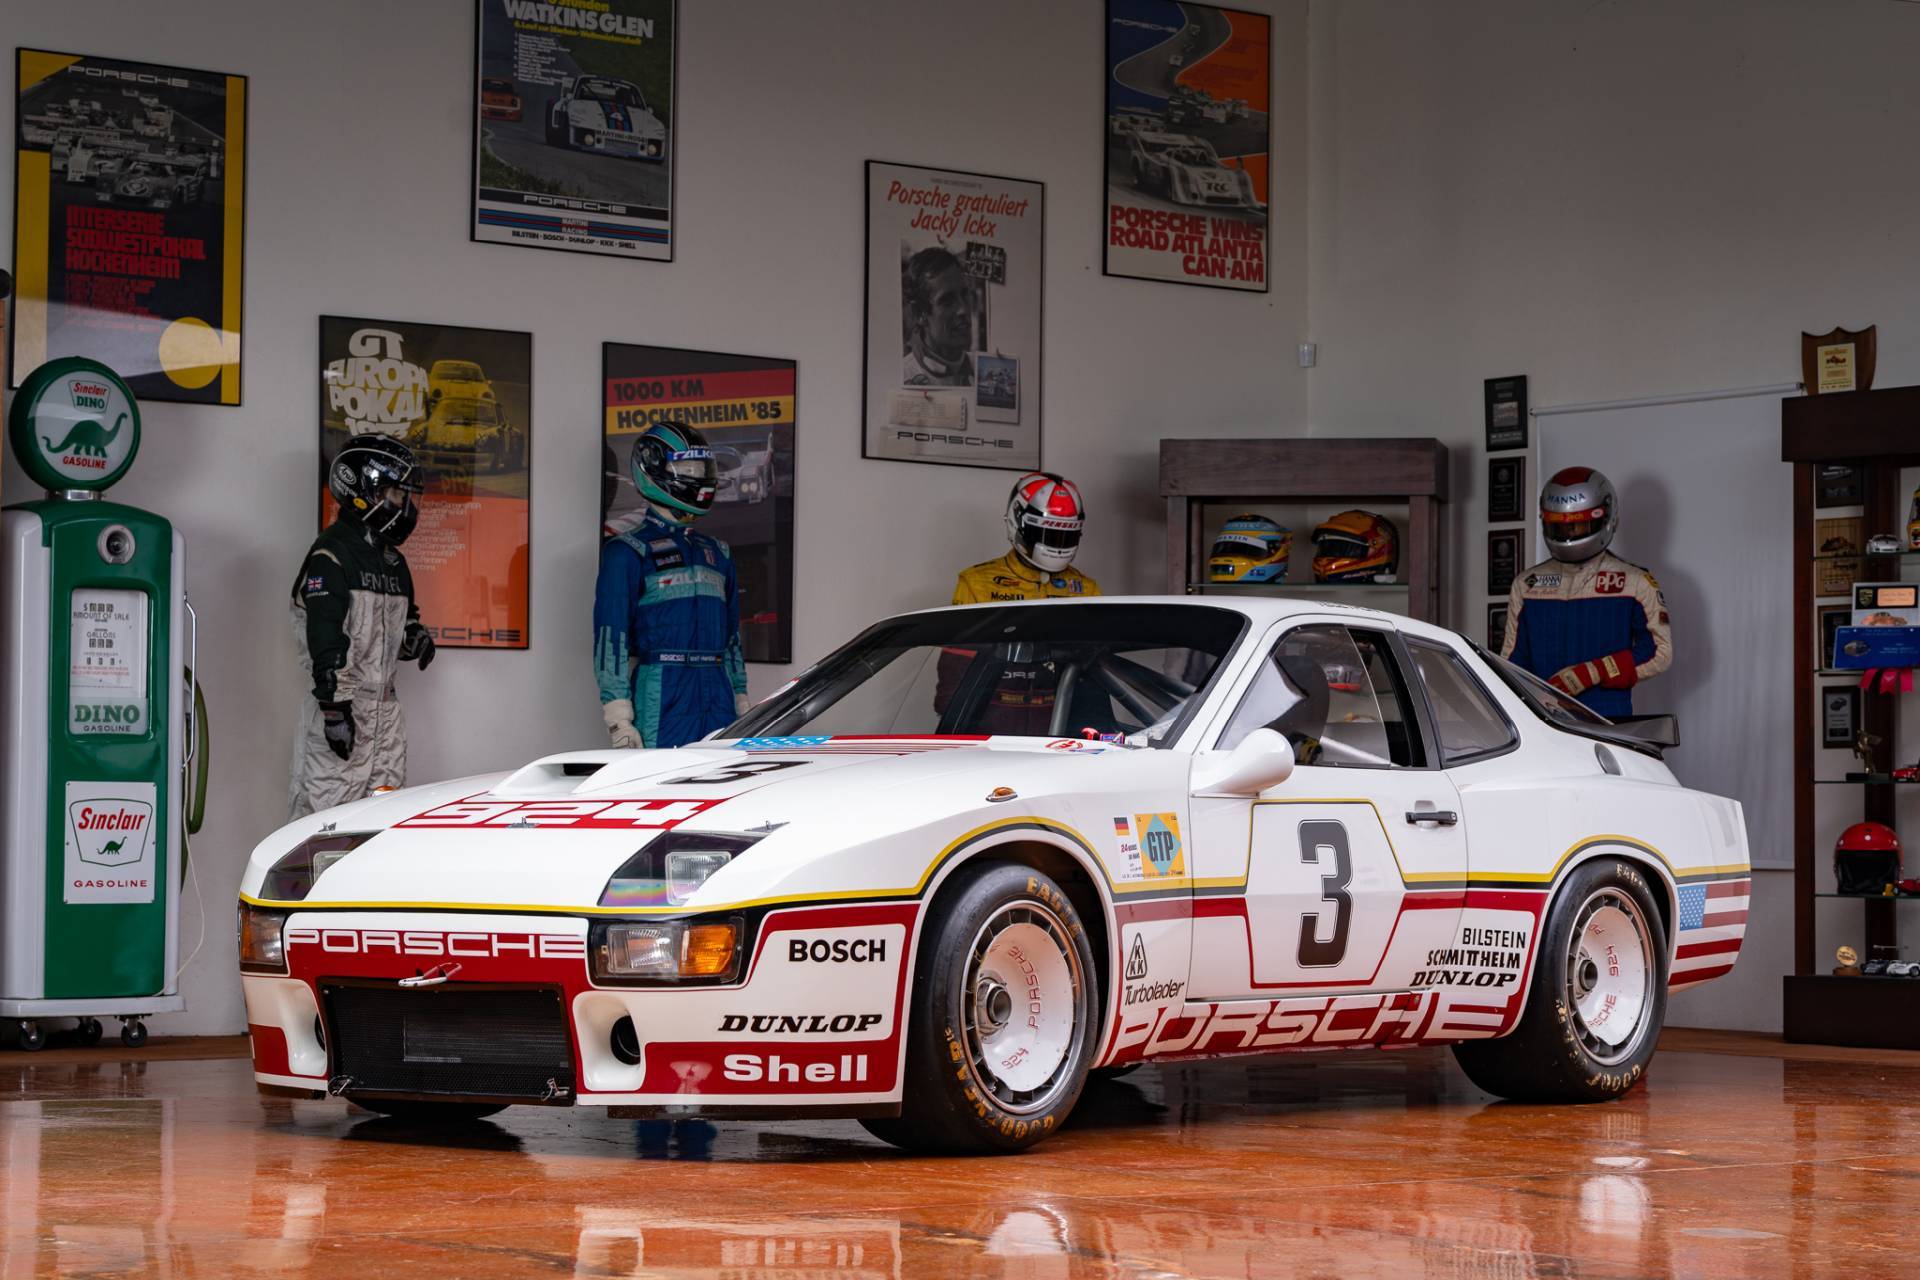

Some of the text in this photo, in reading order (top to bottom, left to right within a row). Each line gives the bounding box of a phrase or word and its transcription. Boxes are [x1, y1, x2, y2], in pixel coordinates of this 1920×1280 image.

[503, 0, 654, 38] WATKINS GLEN
[68, 65, 190, 88] PORSCHE
[523, 194, 627, 214] PORSCHE
[887, 180, 951, 208] Porsche
[952, 193, 1029, 218] gratuliert
[910, 208, 998, 238] Jacky Ickx
[1110, 205, 1264, 242] PORSCHE WINS
[543, 233, 565, 241] BOSCH
[568, 235, 596, 244] DUNLOP
[618, 242, 637, 250] SHELL
[1109, 225, 1264, 262] ROAD ATLANTA
[66, 248, 181, 280] HOCKENHEIM
[348, 328, 404, 360] GT
[73, 382, 107, 396] Sinclair
[613, 378, 705, 402] 1000 KM
[75, 396, 105, 409] DINO
[617, 403, 748, 429] HOCKENHEIM
[896, 431, 1014, 449] PORSCHE
[62, 456, 107, 469] GASOLINE
[991, 591, 1015, 600] Mobil
[73, 611, 130, 621] AMOUNT OF SALE
[86, 631, 116, 639] GALLONS
[74, 704, 140, 724] DINO
[83, 725, 131, 733] GASOLINE
[657, 761, 814, 785] 3
[78, 806, 146, 831] Sinclair
[400, 799, 705, 827] 924
[1146, 831, 1174, 862] GTP
[73, 879, 148, 888] GASOLINE
[1297, 819, 1353, 969] 3
[287, 929, 585, 960] PORSCHE
[1462, 928, 1526, 949] BILSTEIN
[788, 939, 886, 963] BOSCH
[1007, 944, 1042, 1031] PORSCHE
[1409, 970, 1517, 987] DUNLOP
[1124, 979, 1185, 1006] Turbolader
[717, 1013, 883, 1033] DUNLOP
[1108, 990, 1510, 1057] PORSCHE
[723, 1053, 868, 1083] Shell
[1001, 1047, 1029, 1070] 924
